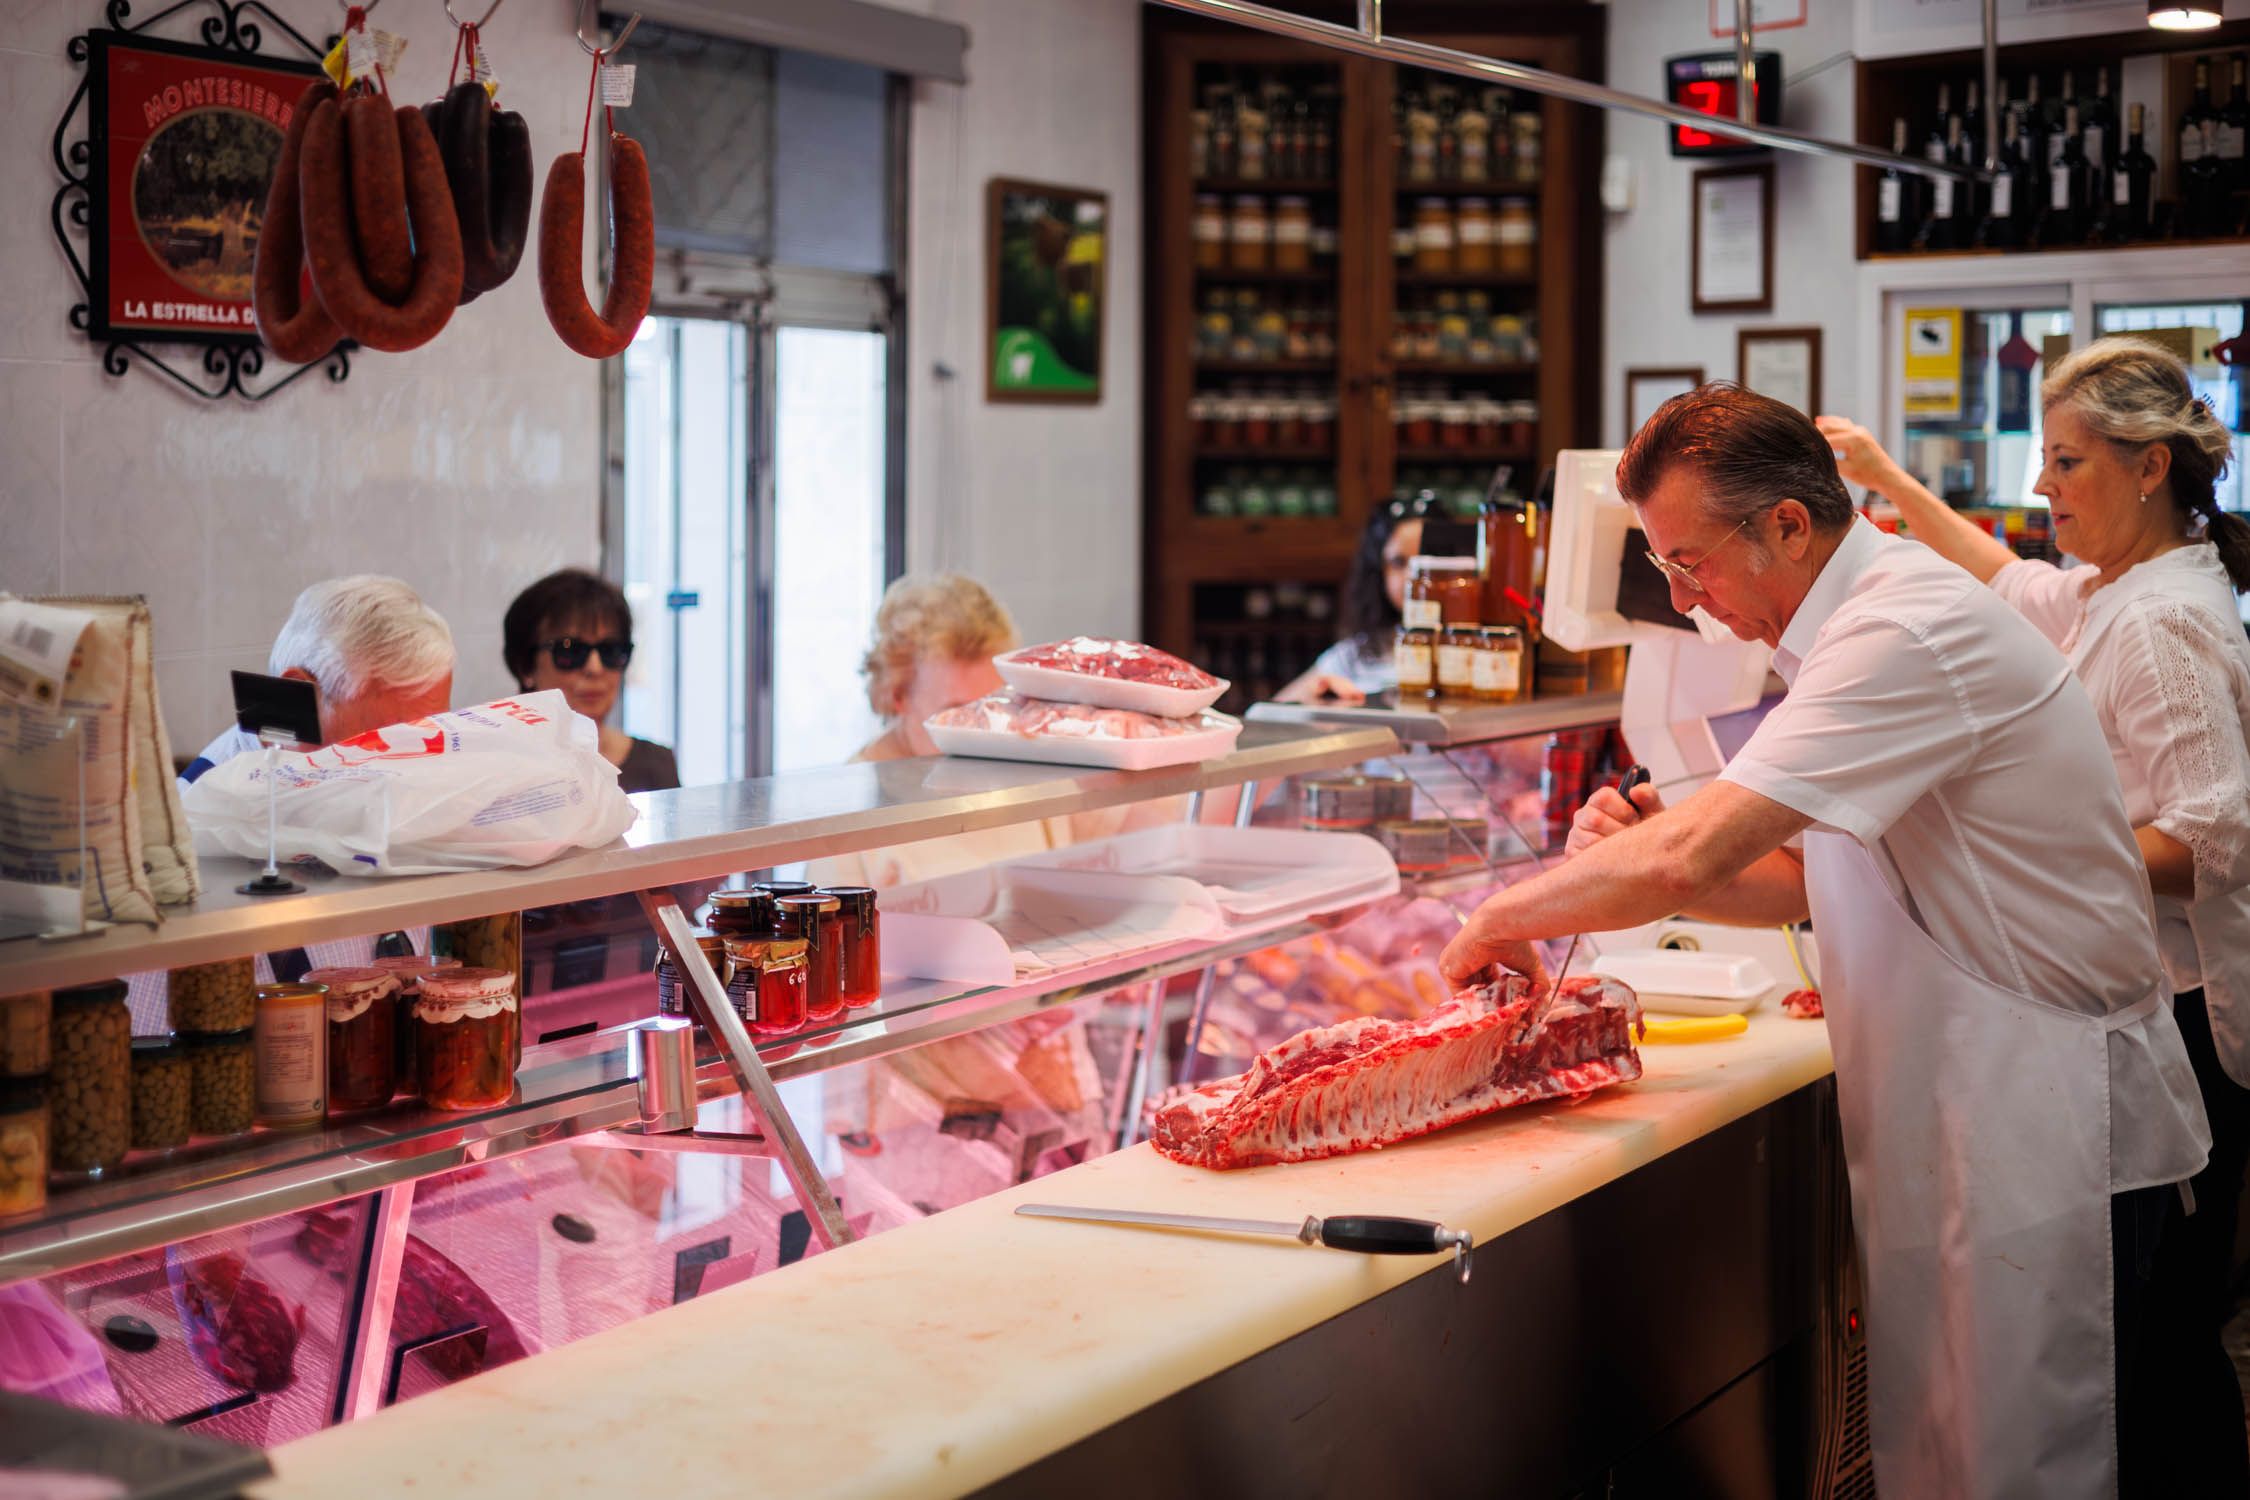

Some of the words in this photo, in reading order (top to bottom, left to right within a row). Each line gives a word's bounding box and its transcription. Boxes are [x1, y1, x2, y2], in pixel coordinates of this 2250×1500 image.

[124, 300, 147, 318] LA
[152, 301, 239, 324] ESTRELLA
[243, 306, 257, 325] D
